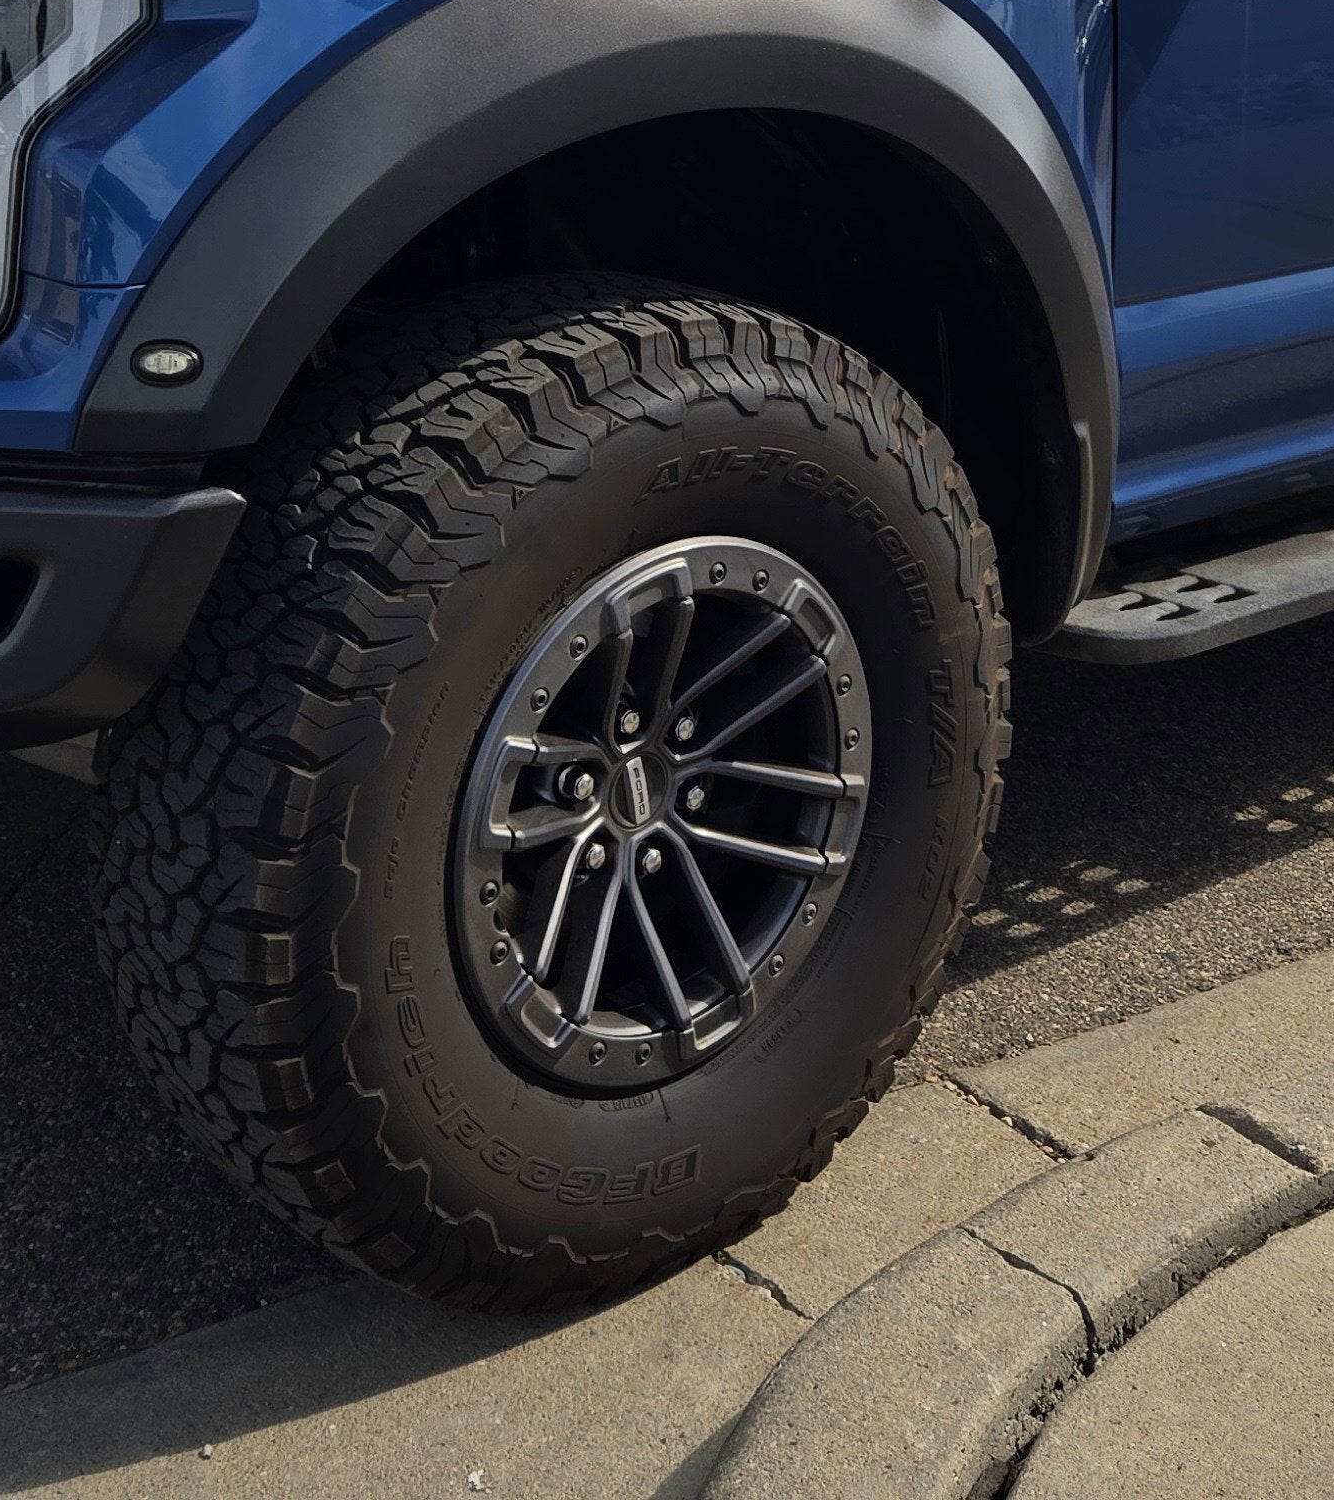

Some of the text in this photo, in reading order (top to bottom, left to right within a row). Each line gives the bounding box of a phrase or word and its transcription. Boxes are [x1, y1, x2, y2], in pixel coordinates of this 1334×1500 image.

[632, 444, 936, 630] All-Terrain
[928, 658, 959, 789] T/A
[632, 767, 645, 815] FORD
[384, 934, 703, 1206] BFGoodrich
